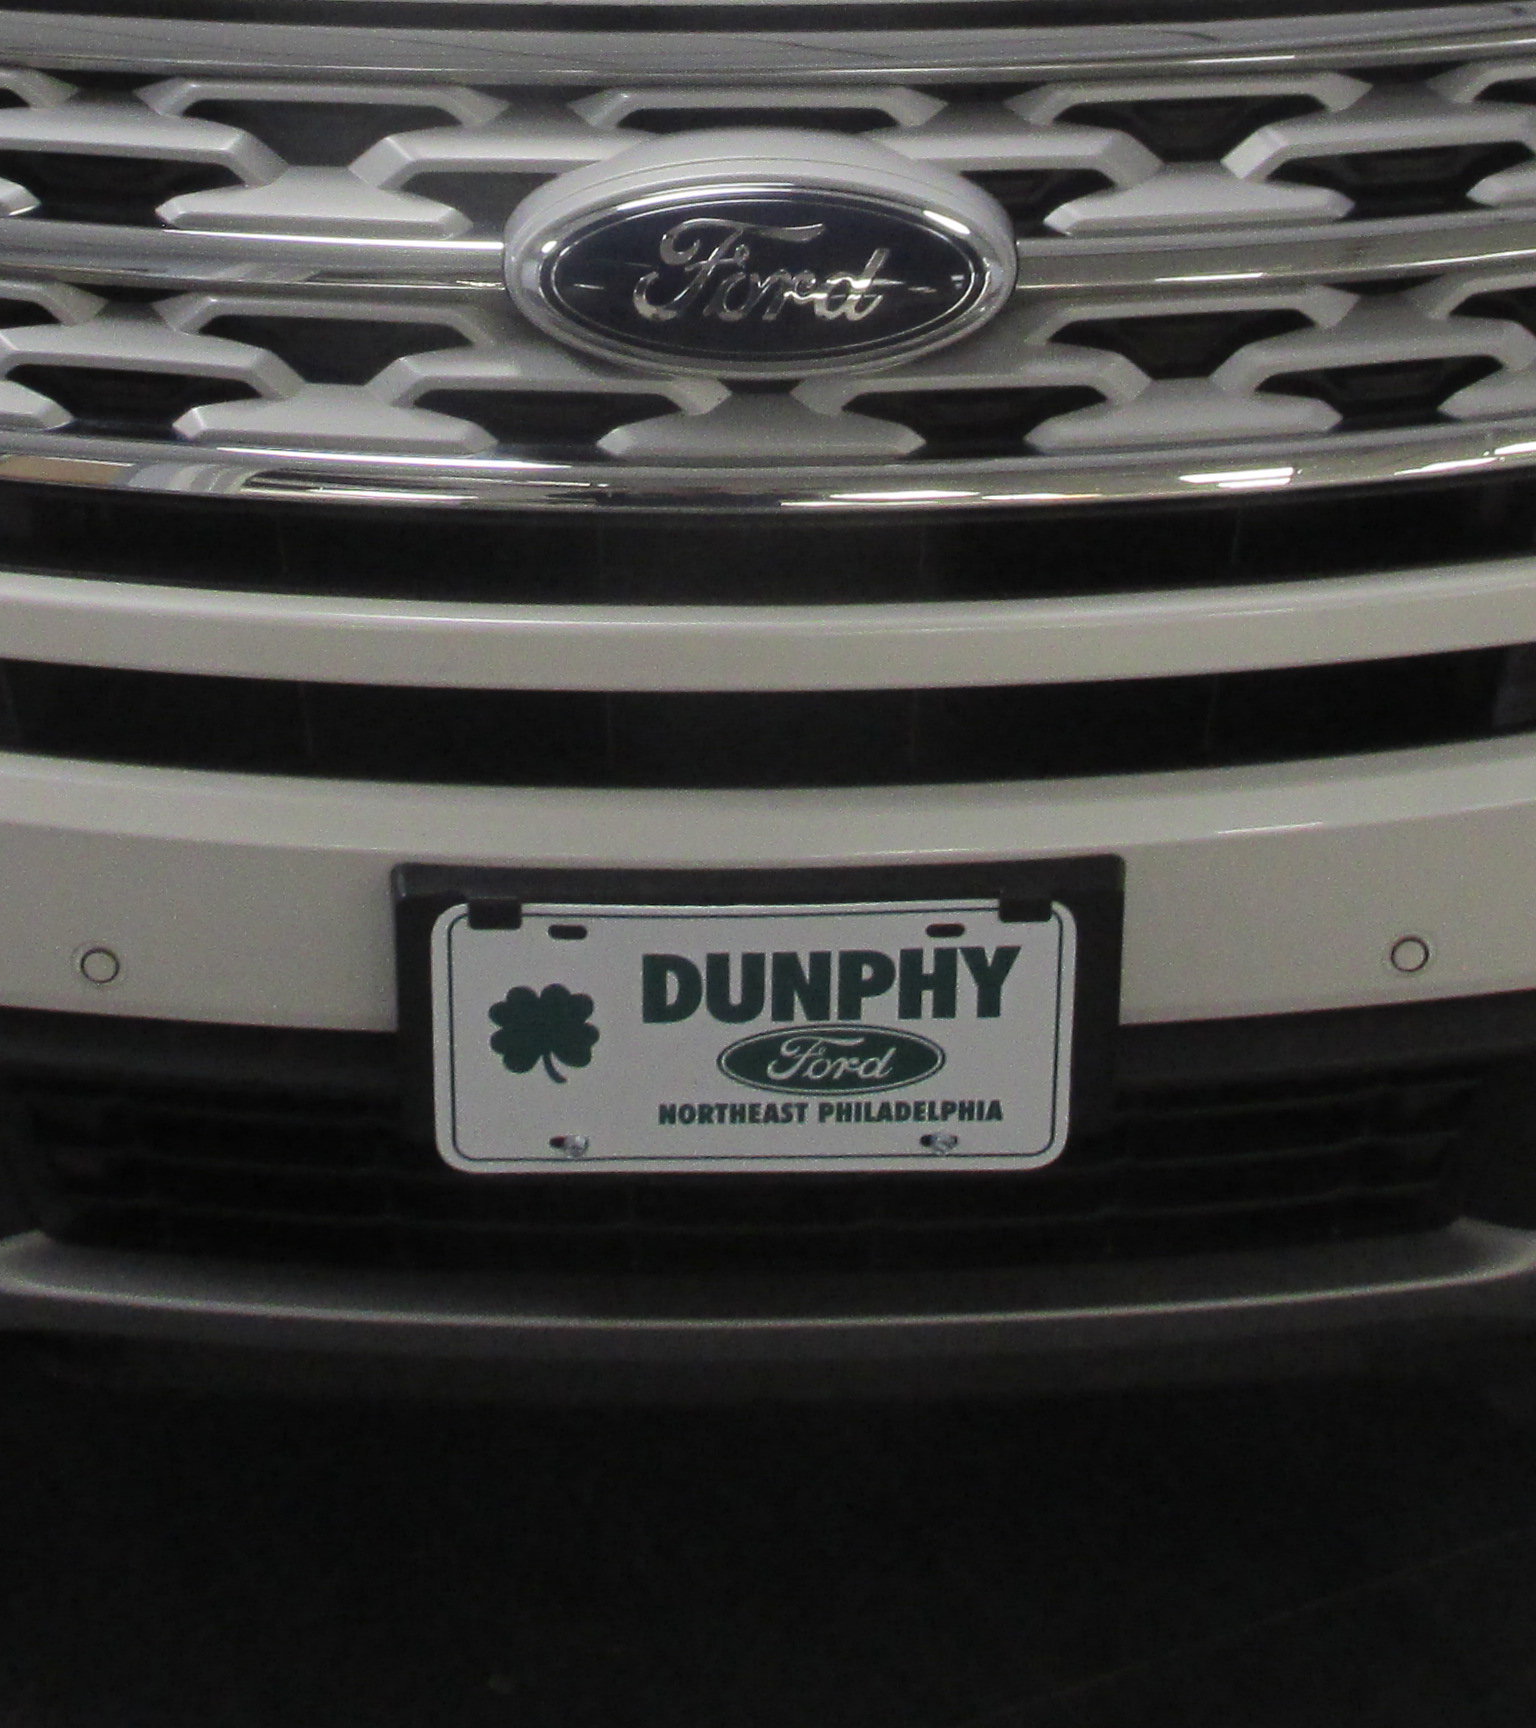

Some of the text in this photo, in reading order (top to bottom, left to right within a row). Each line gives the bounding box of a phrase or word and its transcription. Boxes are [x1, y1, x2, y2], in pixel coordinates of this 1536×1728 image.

[632, 217, 891, 322] Ford
[641, 945, 1023, 1024] DUNPHY
[766, 1035, 897, 1081] Ford
[657, 1099, 1004, 1126] NORTHEAST PHILADELPHIA
